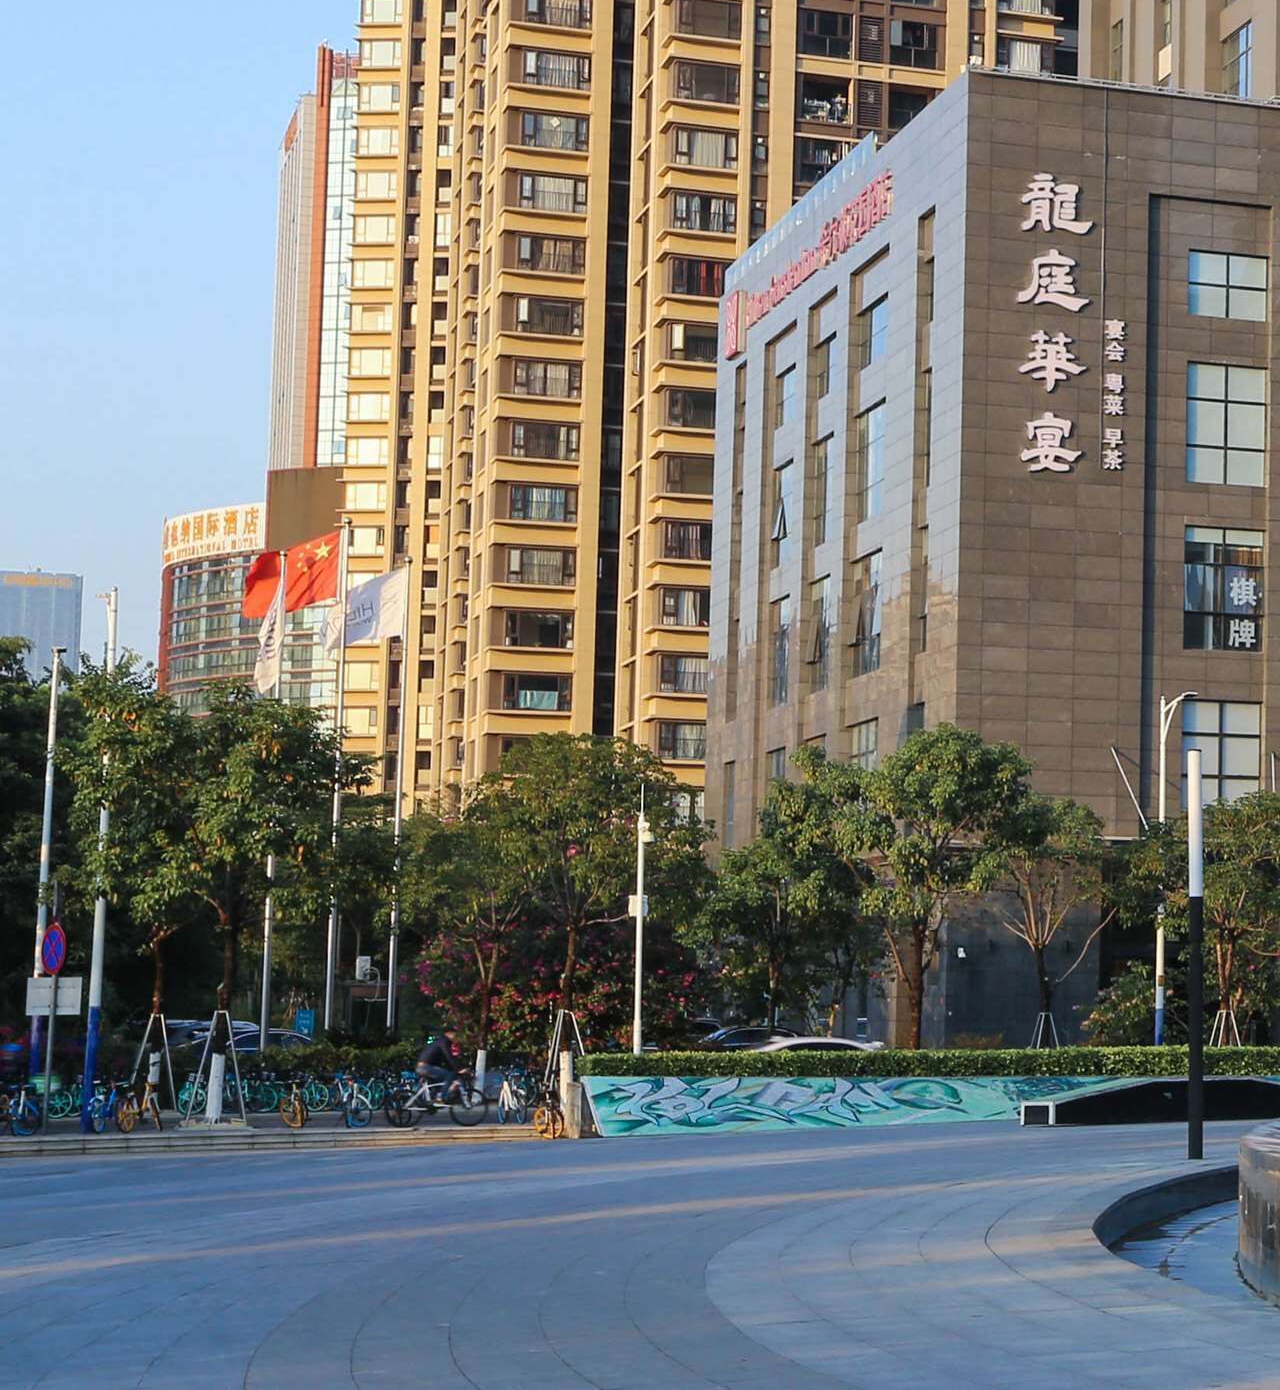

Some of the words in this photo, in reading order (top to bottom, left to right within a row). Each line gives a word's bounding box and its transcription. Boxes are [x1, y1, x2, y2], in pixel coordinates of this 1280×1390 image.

[1017, 172, 1094, 474] 龍庭華宴
[1103, 373, 1125, 416] 粤菜
[1102, 428, 1124, 471] 早茶
[1228, 576, 1257, 648] 棋牌
